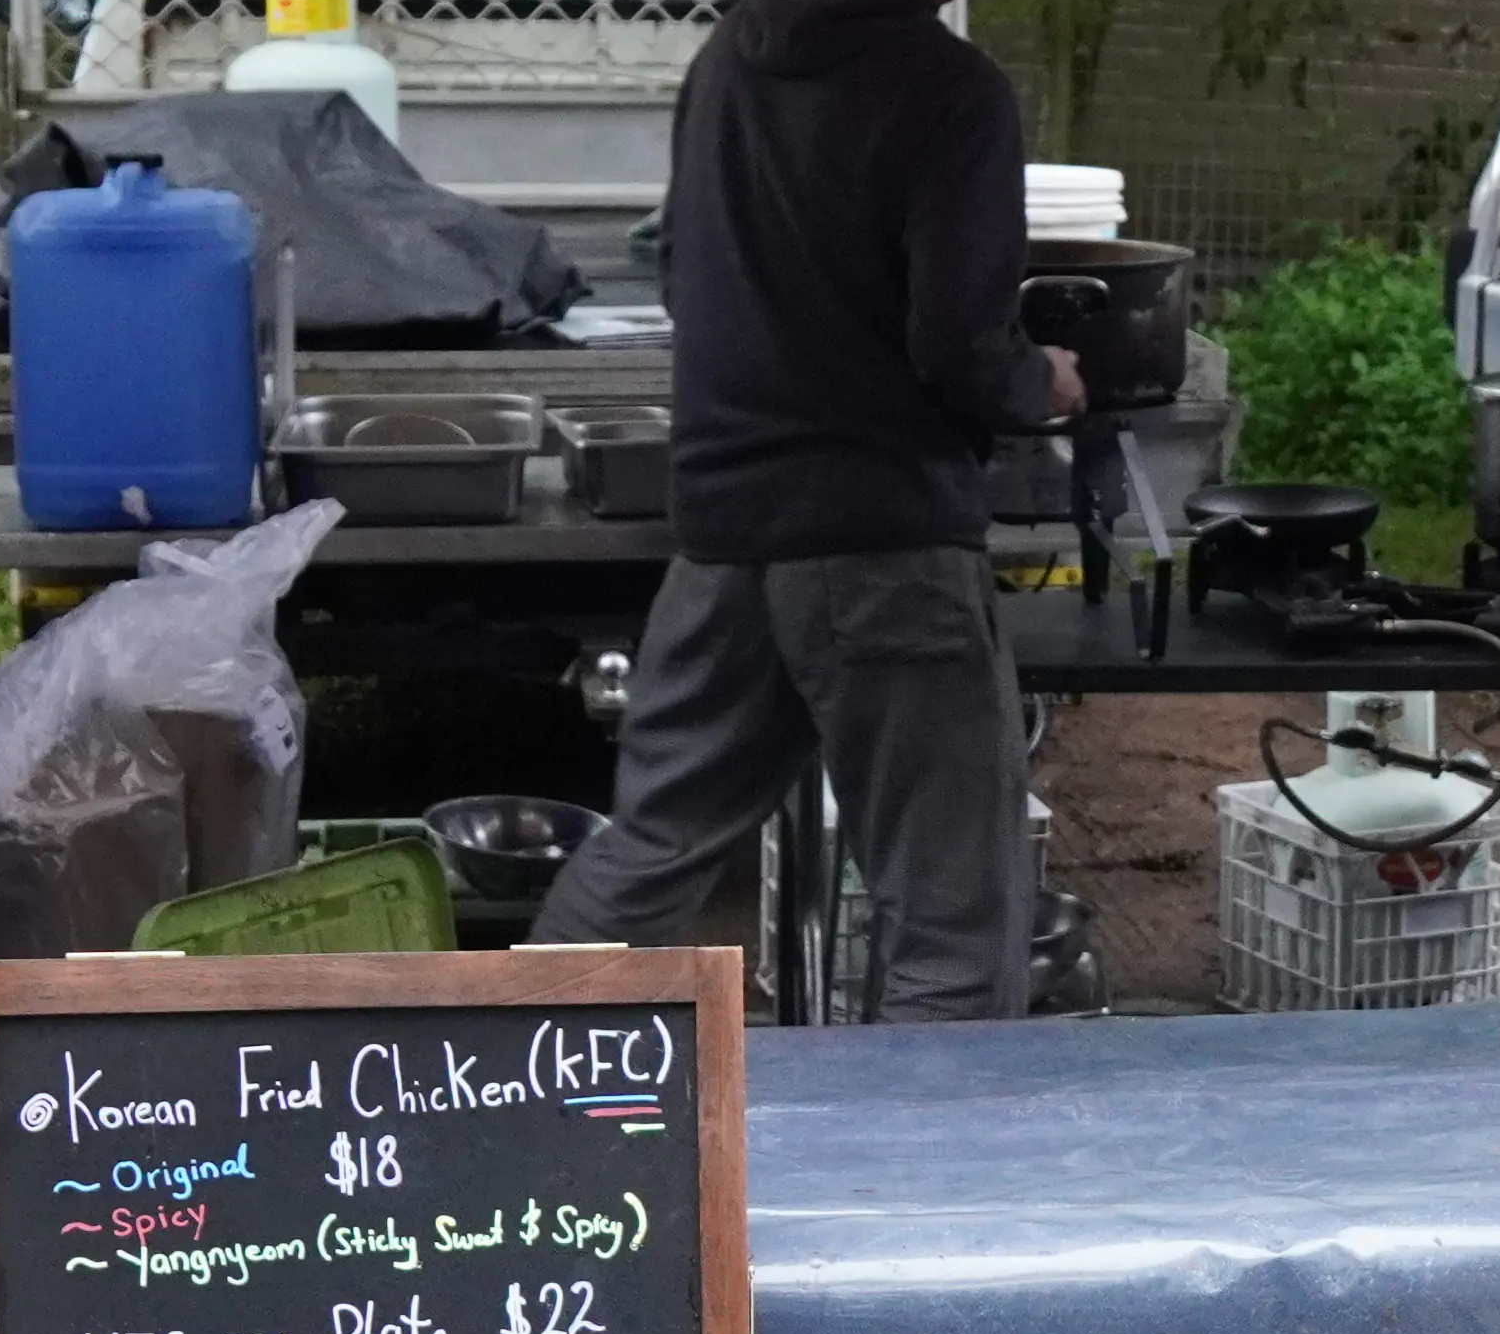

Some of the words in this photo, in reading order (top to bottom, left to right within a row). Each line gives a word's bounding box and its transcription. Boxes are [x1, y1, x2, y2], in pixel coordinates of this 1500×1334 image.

[65, 1051, 196, 1144] Korean
[239, 1045, 322, 1117] Fried
[113, 1143, 256, 1200] Original
[324, 1131, 402, 1195] $18
[112, 1204, 206, 1246] Spicy
